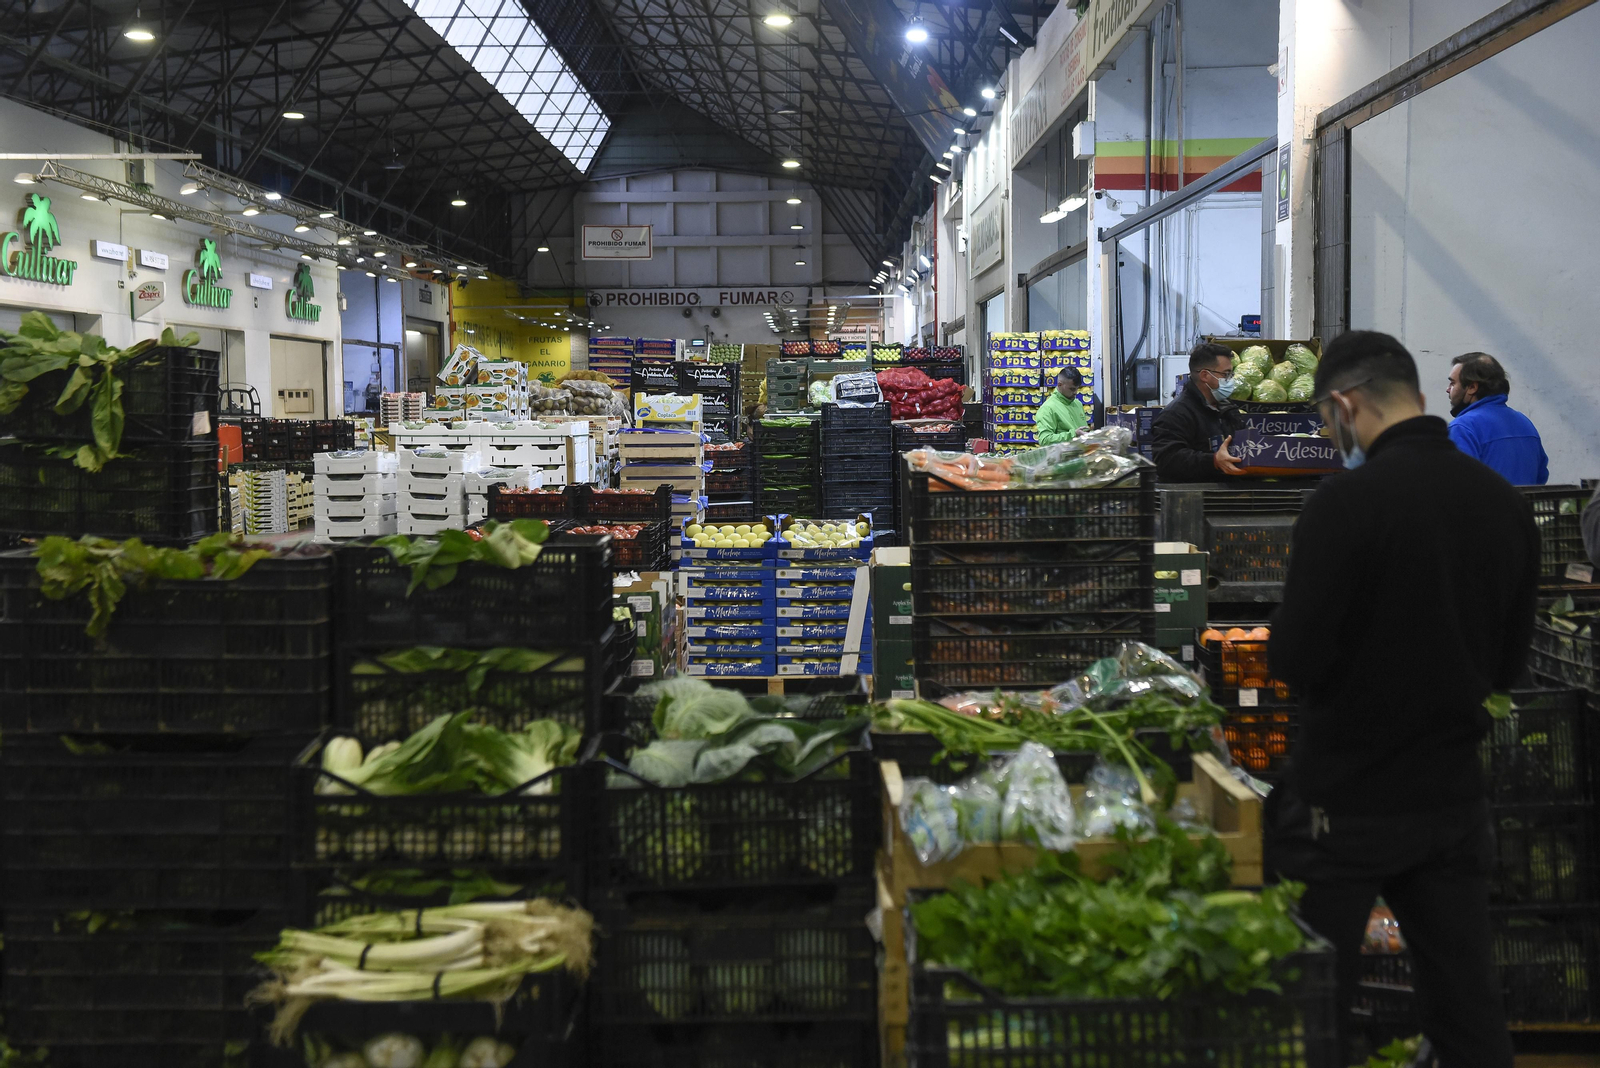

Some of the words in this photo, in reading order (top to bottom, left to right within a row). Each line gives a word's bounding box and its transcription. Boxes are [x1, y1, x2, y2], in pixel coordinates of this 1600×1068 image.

[138, 290, 160, 300] Zespri
[606, 292, 699, 306] PROHIBIDO
[720, 291, 778, 305] FUMAR
[528, 336, 562, 344] FRUTAS
[1005, 340, 1024, 348] FDL
[540, 348, 551, 356] EL
[526, 360, 566, 368] CANARIO
[1006, 358, 1026, 366] FDL
[1006, 376, 1026, 384] FDL
[1246, 418, 1302, 433] Adesur
[1274, 442, 1338, 461] Adesur
